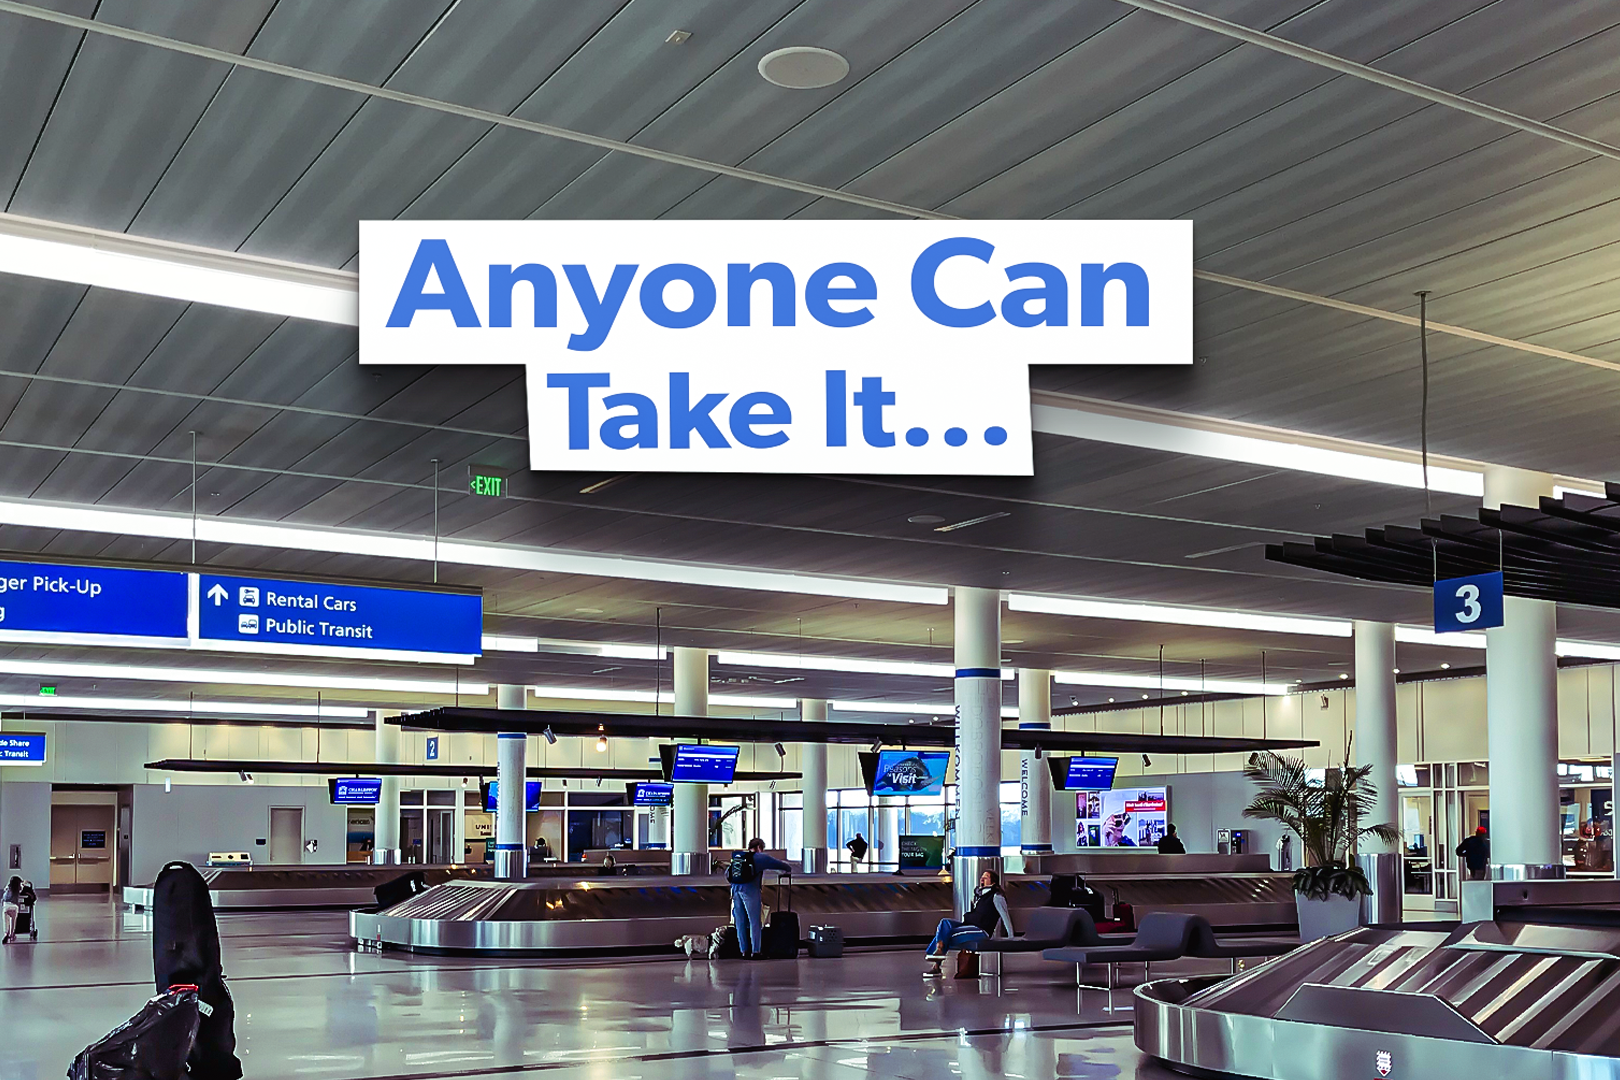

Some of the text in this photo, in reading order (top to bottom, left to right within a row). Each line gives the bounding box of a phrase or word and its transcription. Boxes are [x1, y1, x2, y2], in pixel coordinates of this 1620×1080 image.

[476, 475, 502, 496] EXIT
[33, 576, 102, 598] Pick-Up
[266, 591, 357, 612] Rental Cars
[1455, 584, 1482, 624] 3
[266, 618, 373, 639] Public Transit
[9, 739, 30, 747] Share
[429, 740, 435, 757] 2
[4, 750, 29, 758] Transit
[892, 772, 917, 784] Visit
[1021, 758, 1029, 817] WELCOME
